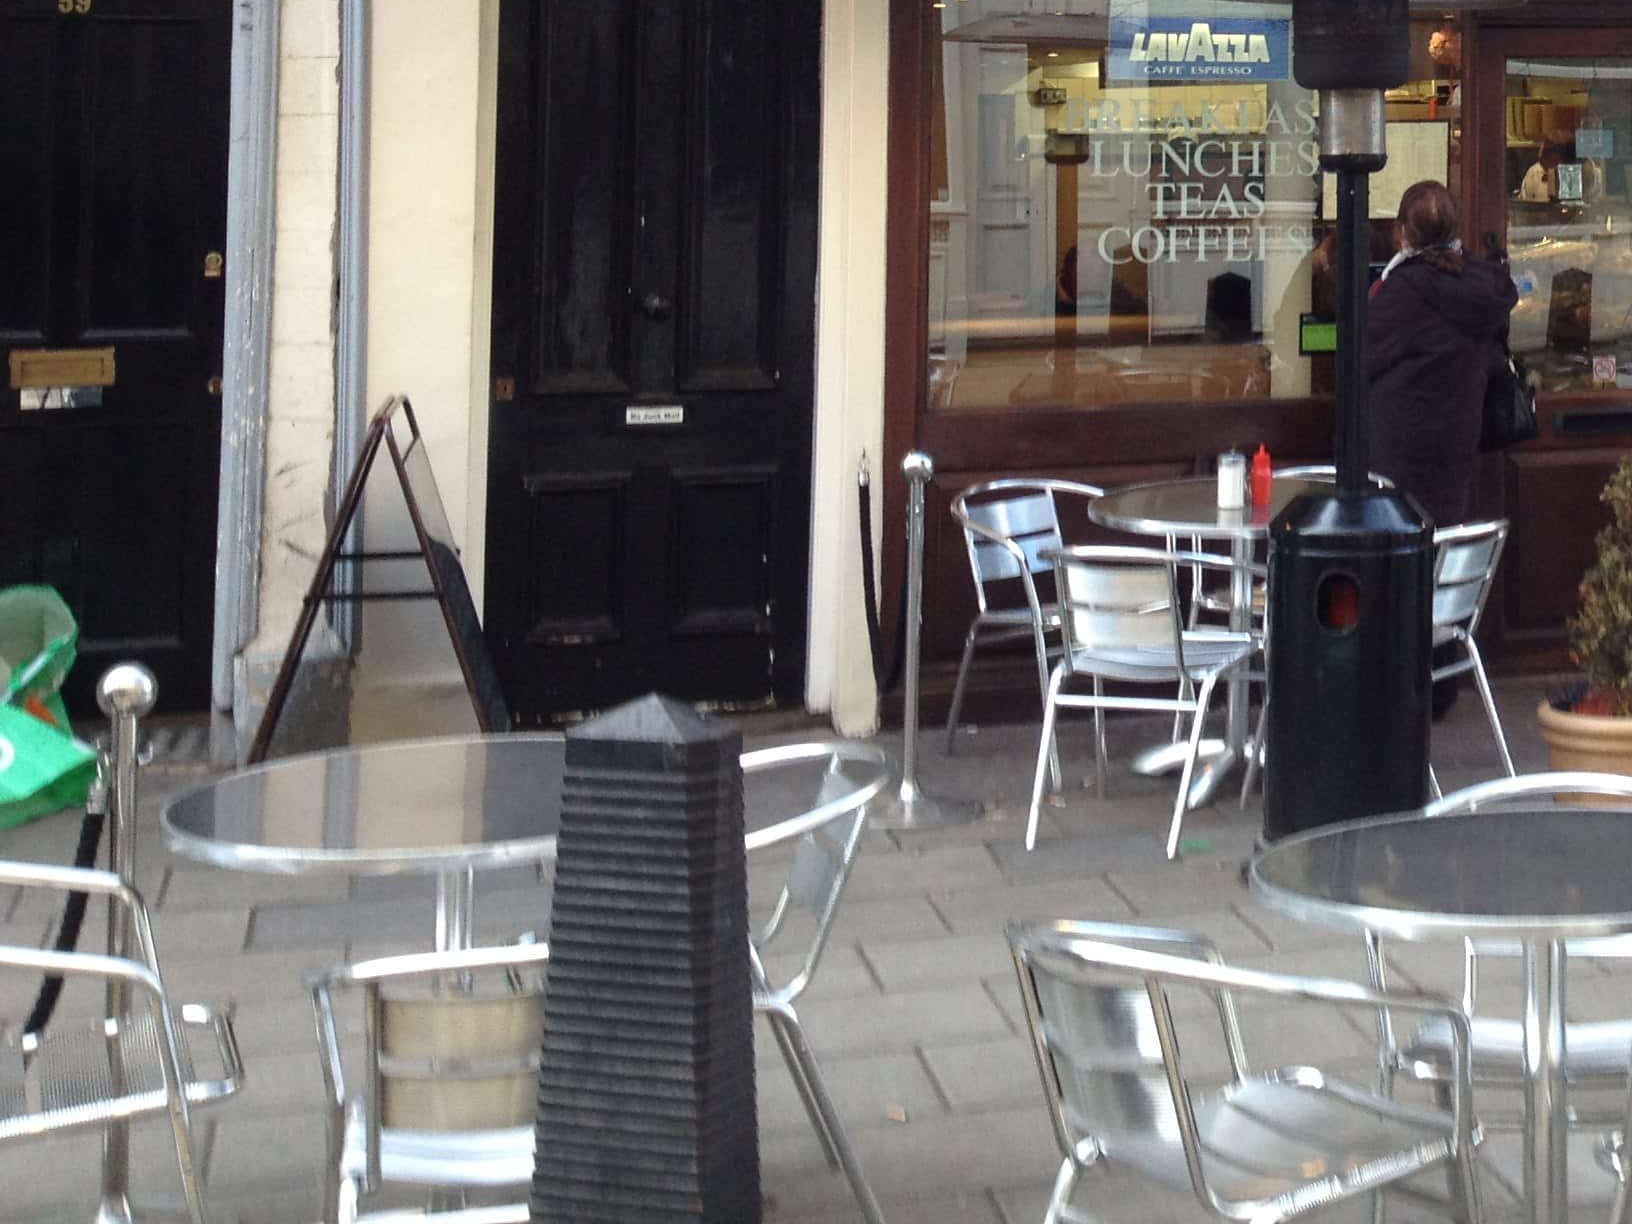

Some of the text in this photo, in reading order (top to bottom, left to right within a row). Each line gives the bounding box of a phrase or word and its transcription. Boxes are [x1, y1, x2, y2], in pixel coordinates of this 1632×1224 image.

[1129, 22, 1271, 64] LAVAZZA
[1190, 65, 1252, 76] ESPRESSO
[1066, 97, 1318, 136] BREAKFAS
[1091, 140, 1320, 178] LUNCHES
[1145, 182, 1266, 220] TEAS
[1097, 225, 1311, 265] COFFEES
